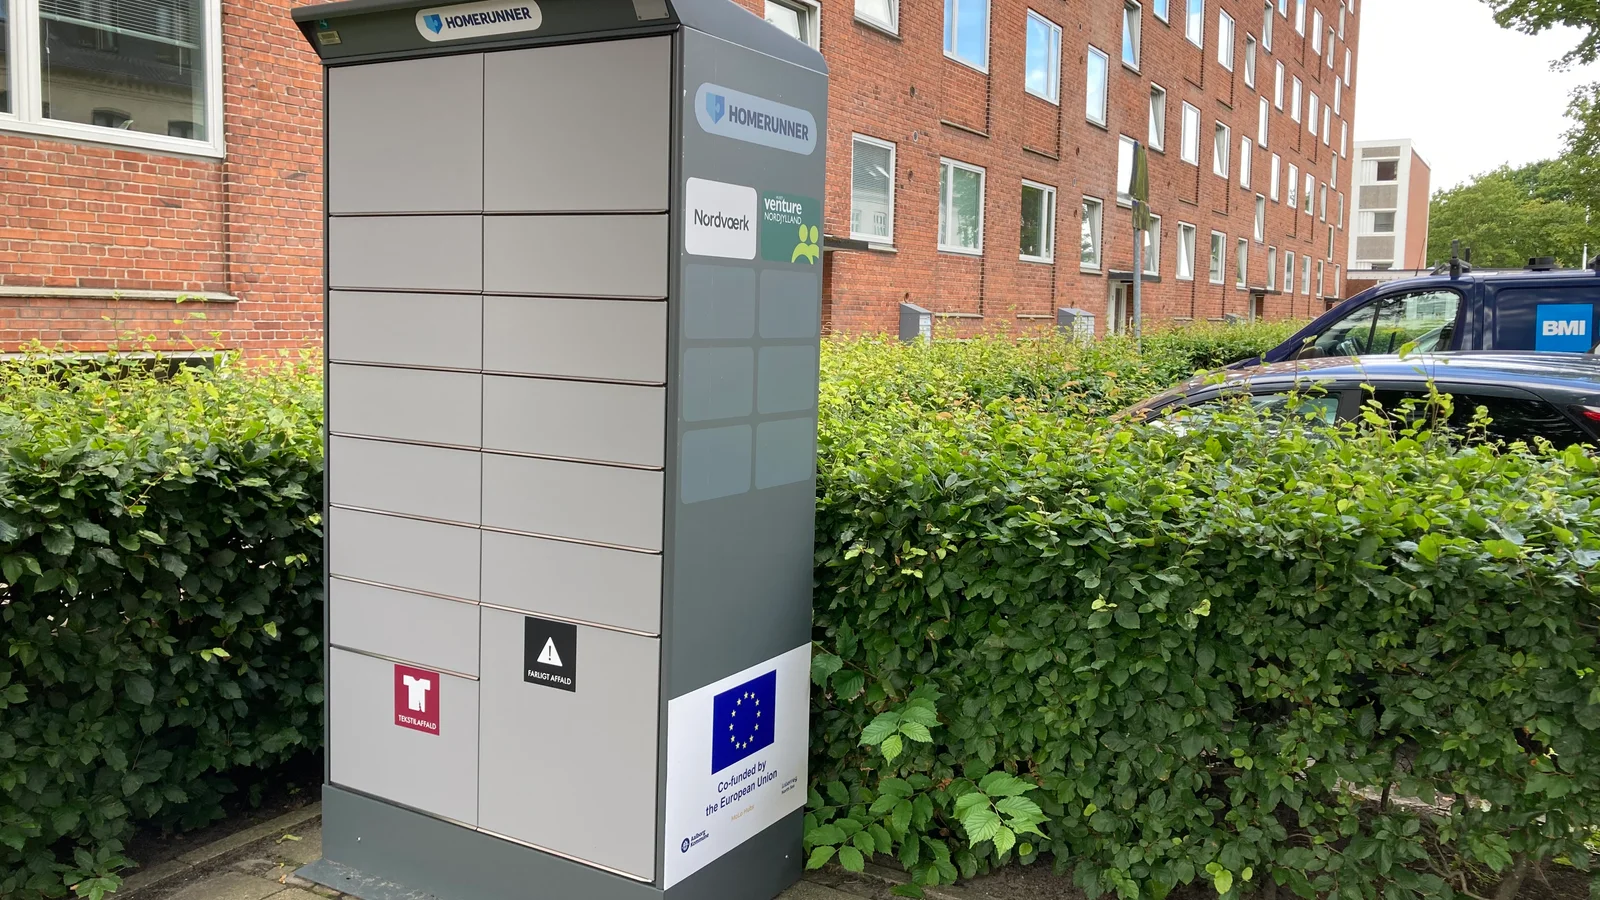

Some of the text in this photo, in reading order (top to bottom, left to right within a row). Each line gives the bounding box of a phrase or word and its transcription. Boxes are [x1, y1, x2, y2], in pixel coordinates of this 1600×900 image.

[445, 7, 532, 29] HOMERUNNER
[729, 105, 809, 141] HOMERUNNER
[764, 197, 802, 215] venture
[694, 208, 750, 232] Nordværk
[764, 212, 802, 225] NORDJYLLAND
[1542, 320, 1586, 336] BMI
[528, 669, 572, 686] FARLIGT AFFALD
[398, 714, 437, 730] TEKSTILAFFALD
[717, 760, 767, 793] Co-funded by
[705, 769, 778, 817] the European Union
